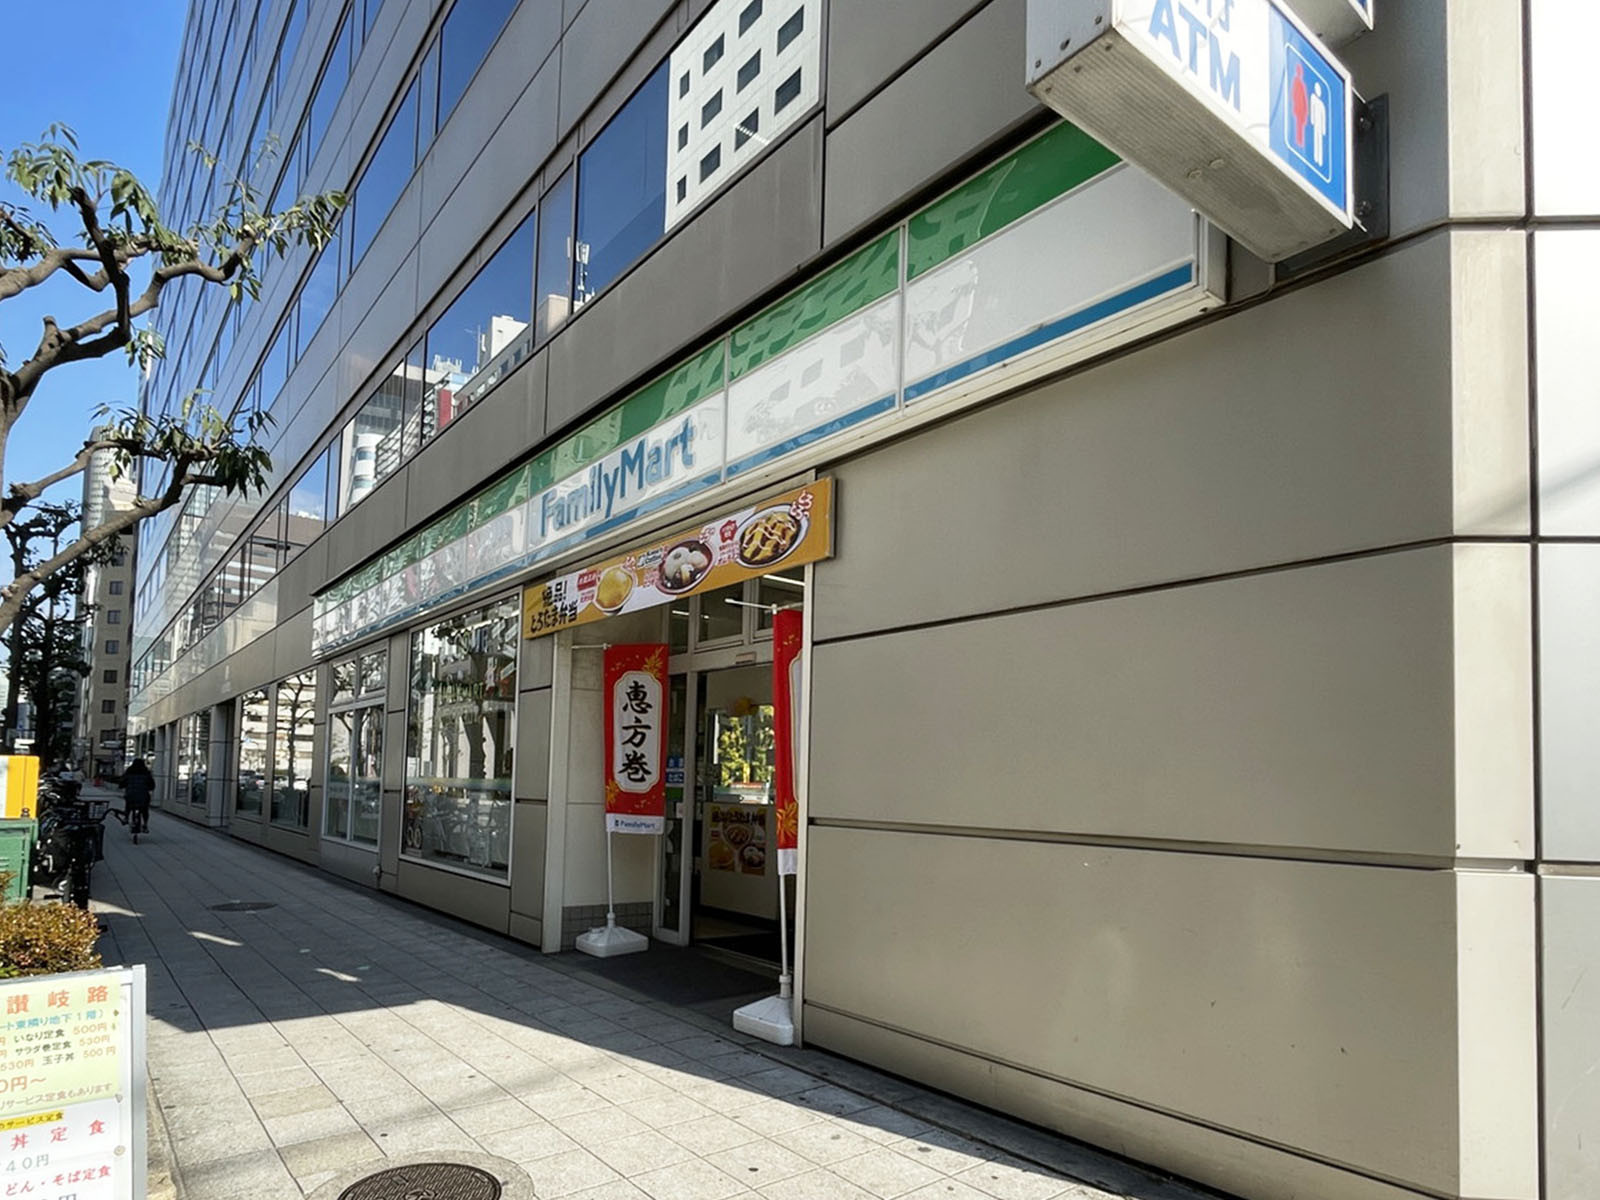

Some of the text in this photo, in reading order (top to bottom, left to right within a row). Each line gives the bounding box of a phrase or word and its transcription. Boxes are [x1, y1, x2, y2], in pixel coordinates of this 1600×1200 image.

[1149, 0, 1240, 112] ATM
[541, 416, 696, 537] FamilyMart
[618, 680, 652, 782] 恵方巻
[14, 1029, 65, 1043] いなり定食
[0, 1154, 50, 1172] 40円
